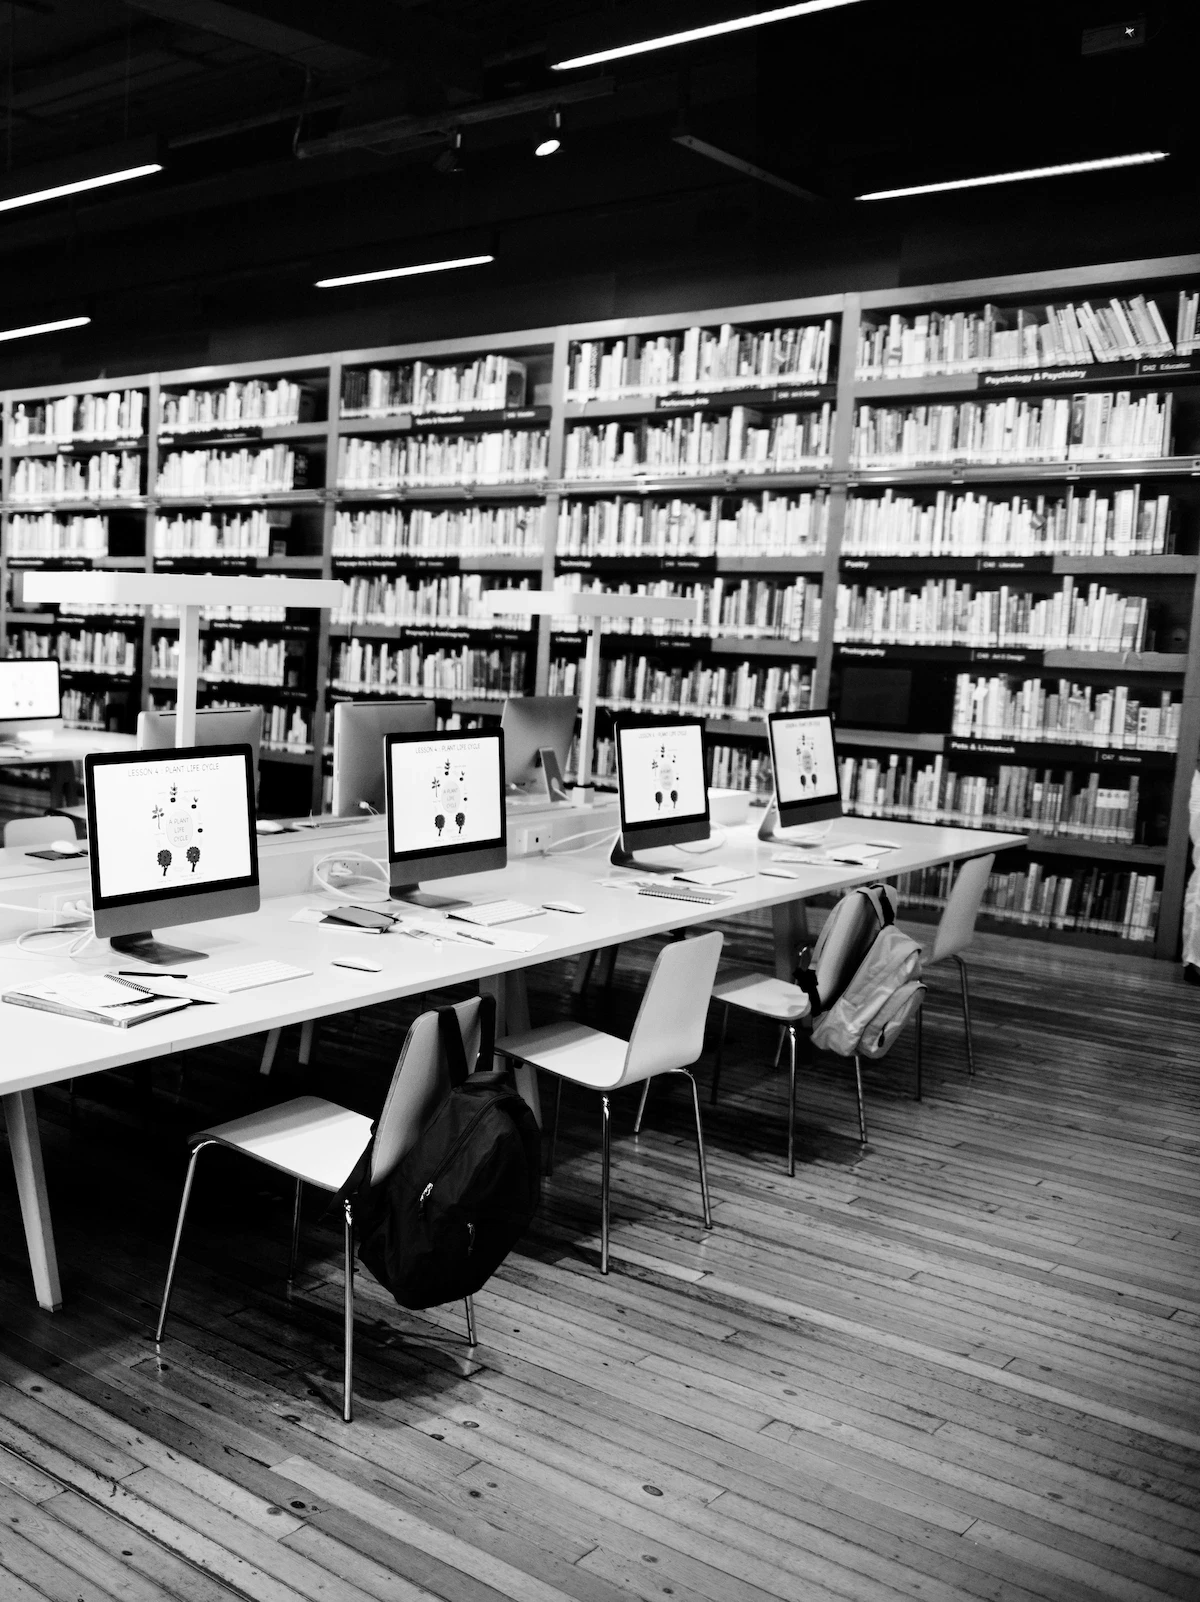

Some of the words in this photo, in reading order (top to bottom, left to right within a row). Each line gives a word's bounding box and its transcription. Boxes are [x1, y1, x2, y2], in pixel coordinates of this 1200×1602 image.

[1160, 362, 1191, 370] Education
[985, 374, 1033, 385] Psychology
[1034, 372, 1041, 380] &
[1042, 369, 1086, 381] Psychiatry
[560, 560, 591, 568] Technology
[845, 560, 869, 569] Poetry
[840, 646, 886, 657] Photography
[416, 746, 433, 754] LESSON
[442, 744, 457, 752] PLANT
[951, 741, 968, 750] Pets
[977, 744, 1016, 754] Livestock
[1119, 755, 1142, 763] Science
[128, 767, 153, 777] LESSON
[165, 765, 184, 774] PLANT
[187, 764, 199, 772] LIFE
[202, 762, 220, 771] CYCLE
[174, 817, 190, 825] PLANT
[174, 834, 189, 843] CYCLE
